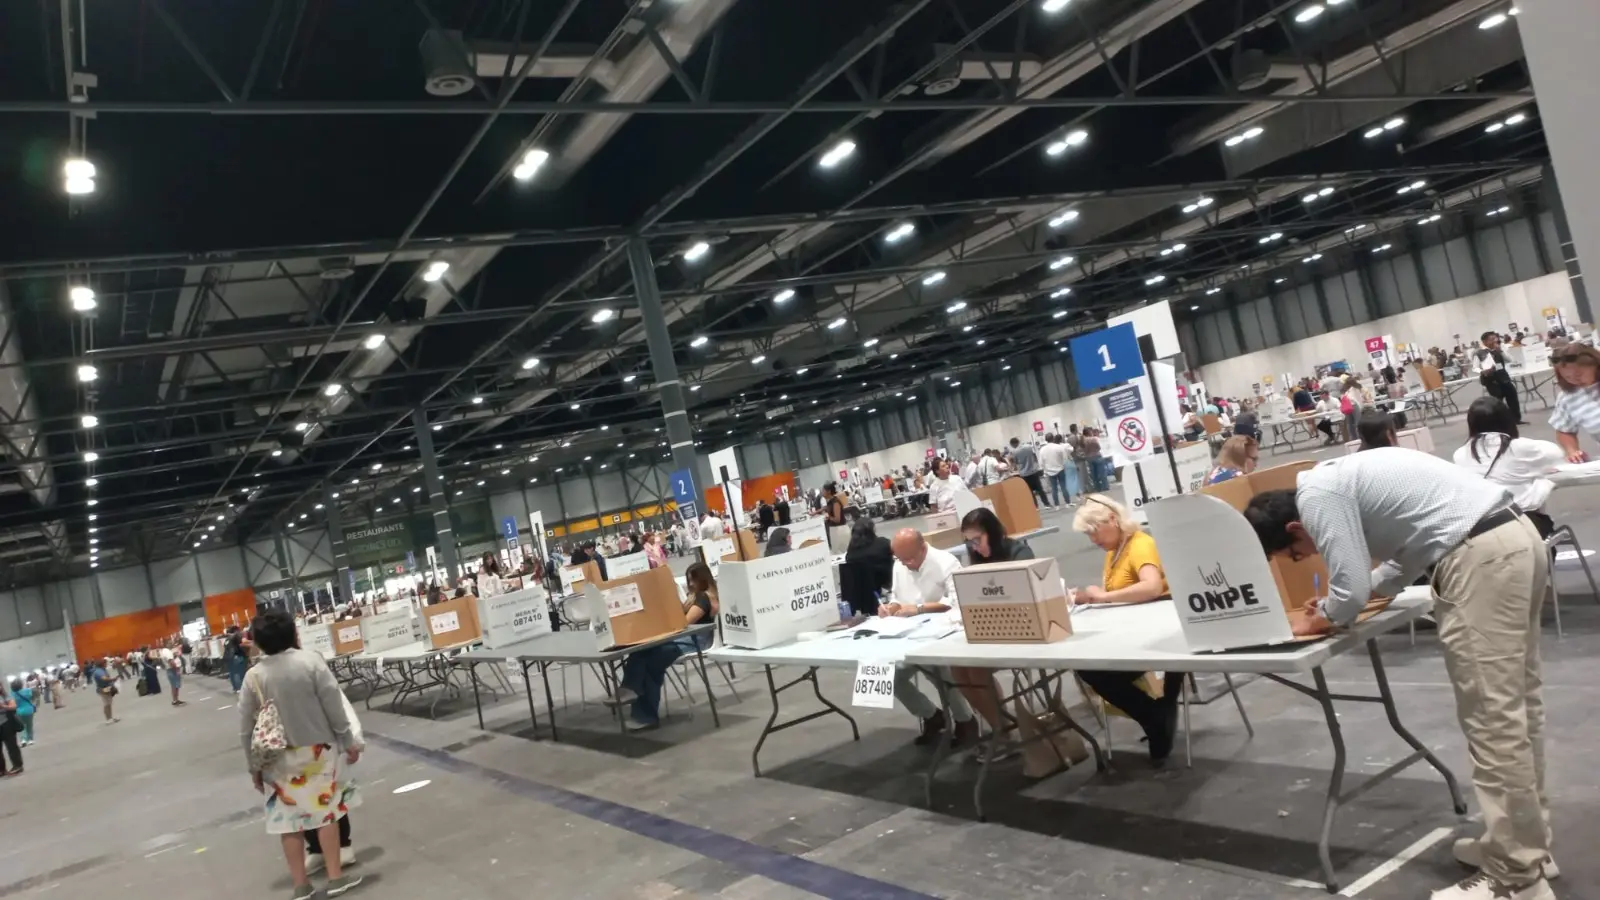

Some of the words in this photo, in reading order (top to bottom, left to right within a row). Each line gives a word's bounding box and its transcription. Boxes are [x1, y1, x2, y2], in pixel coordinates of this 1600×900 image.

[1370, 340, 1379, 349] 47
[1097, 344, 1116, 371] 1
[678, 479, 687, 496] 2
[346, 522, 405, 541] RESTAURANTE
[506, 522, 512, 535] 3
[756, 569, 783, 581] CABINA
[784, 566, 793, 574] DE
[793, 584, 817, 597] MESA
[982, 586, 1005, 596] ONPE
[791, 590, 830, 611] 087409
[1188, 583, 1259, 613] ONPE
[756, 605, 775, 614] MESA
[513, 613, 542, 627] 087410
[725, 613, 749, 627] ONPE
[861, 665, 881, 676] MESA
[855, 679, 892, 696] 087409
